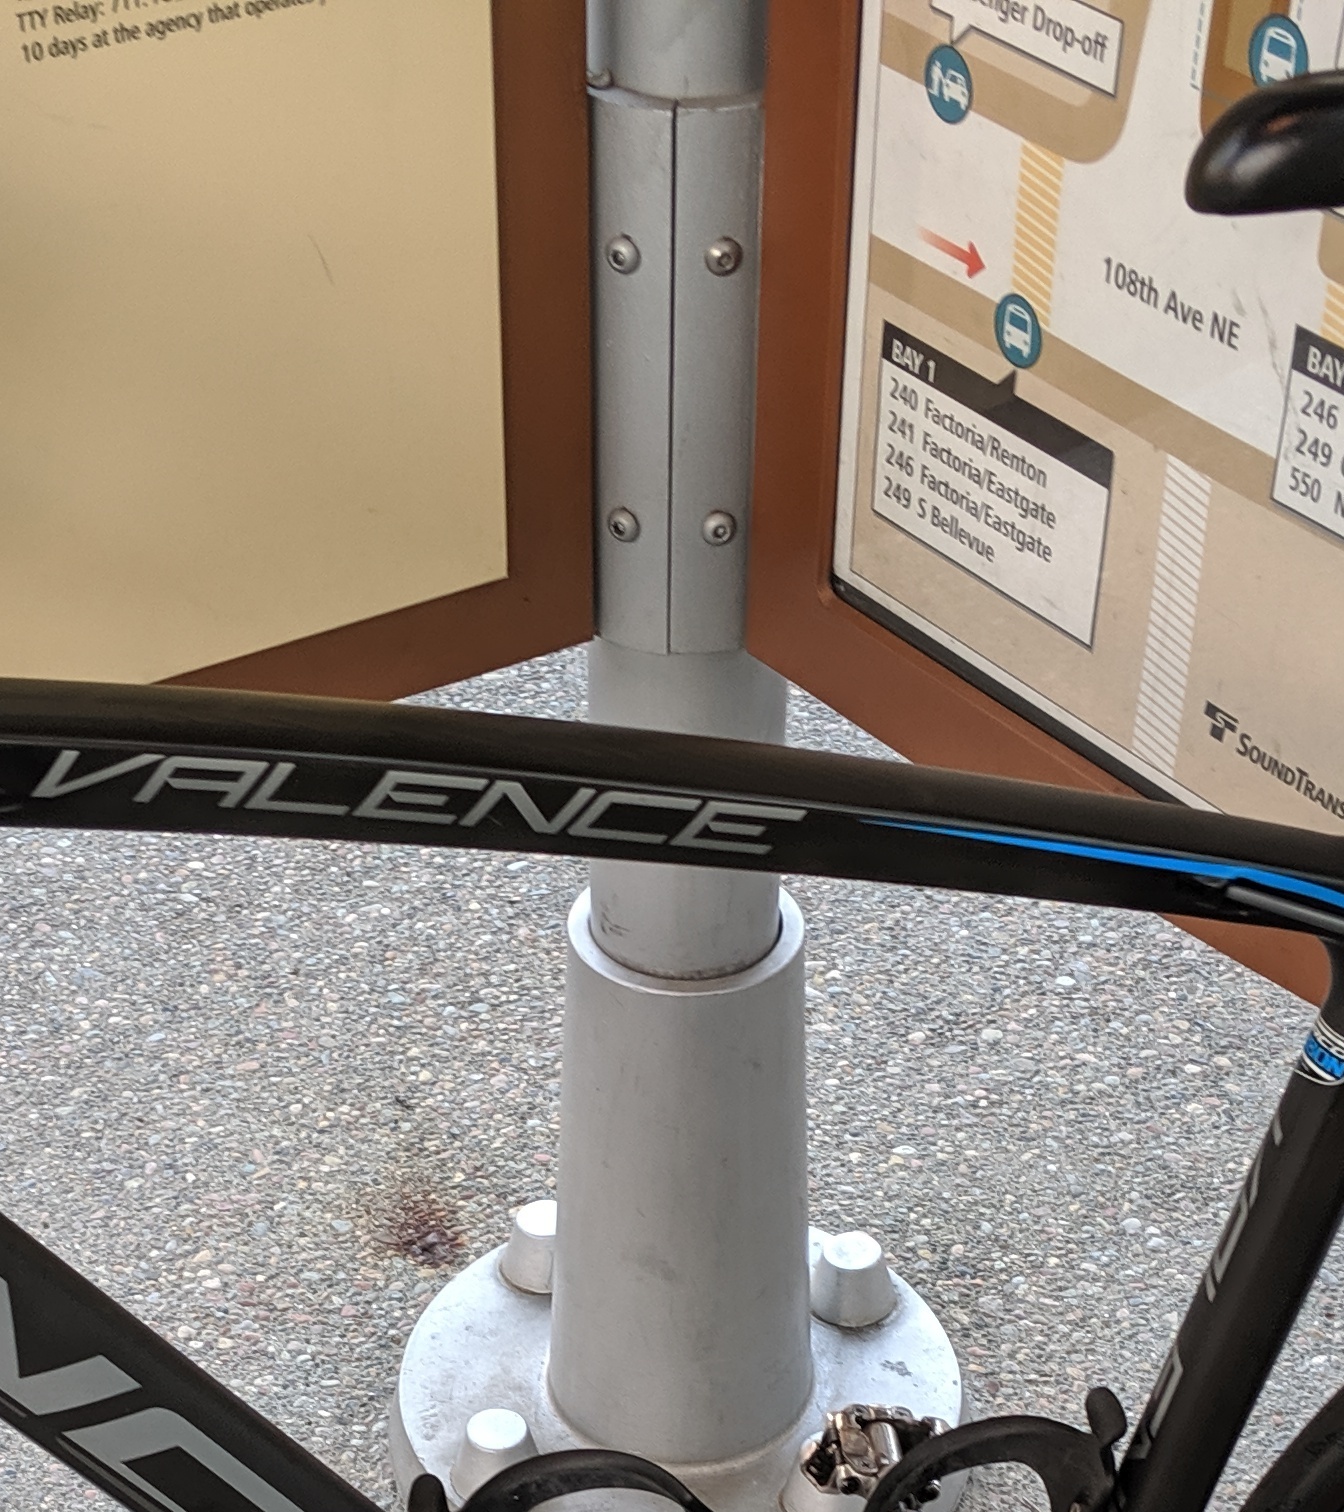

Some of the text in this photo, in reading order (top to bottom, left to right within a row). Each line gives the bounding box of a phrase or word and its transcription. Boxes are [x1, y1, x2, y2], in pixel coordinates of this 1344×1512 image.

[15, 8, 48, 33] TTY
[53, 1, 106, 26] Relay:
[21, 41, 44, 63] 10
[47, 36, 89, 59] days
[91, 29, 111, 49] at
[112, 22, 142, 44] the
[144, 12, 203, 40] agency
[207, 2, 242, 24] that
[1032, 5, 1109, 63] Drop-off
[1104, 256, 1241, 351] 108th Ave NE
[891, 338, 937, 383] BAY 1
[890, 376, 1048, 489] 240 Factoria/Renton
[1300, 389, 1339, 430] 246
[888, 409, 1056, 530] 241 Factoria/Eastgate
[1294, 427, 1333, 468] 249
[885, 442, 1053, 563] 246 Factoria/Eastgate
[1288, 465, 1321, 503] 550
[883, 475, 995, 563] 249 S Bellevue
[31, 750, 807, 855] VALENCE
